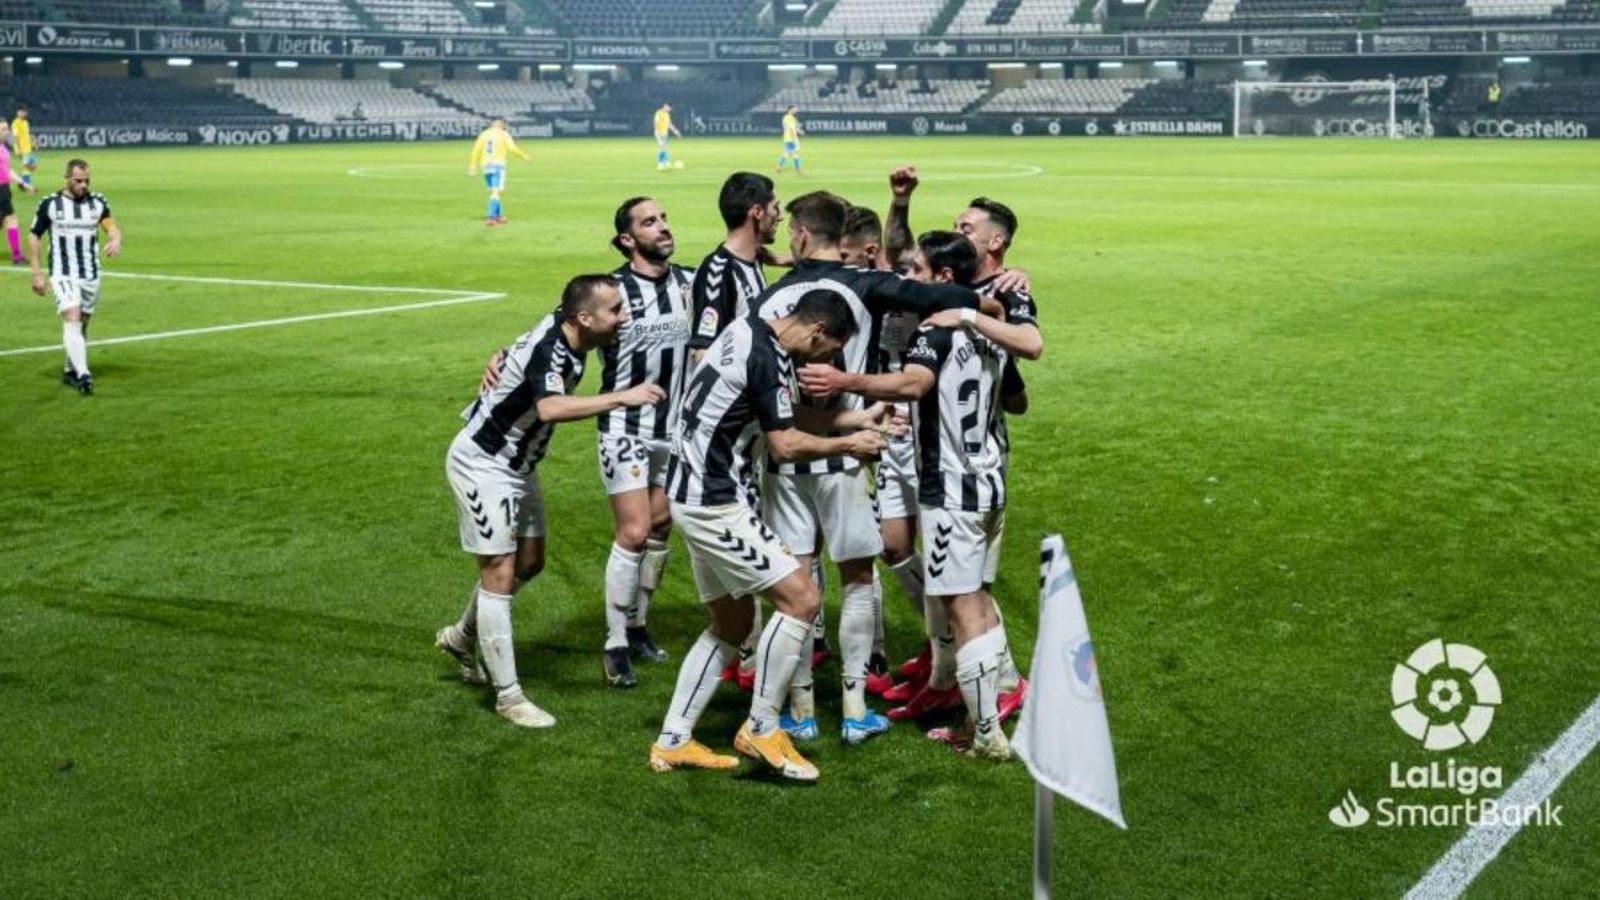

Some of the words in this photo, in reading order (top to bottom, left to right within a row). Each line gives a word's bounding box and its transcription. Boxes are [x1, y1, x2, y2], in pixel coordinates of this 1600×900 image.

[592, 46, 650, 55] HONDA
[806, 120, 853, 131] ESTRELLA
[1130, 121, 1184, 133] ESTRELLA
[1186, 121, 1222, 133] DAMM
[218, 131, 271, 145] NOVO
